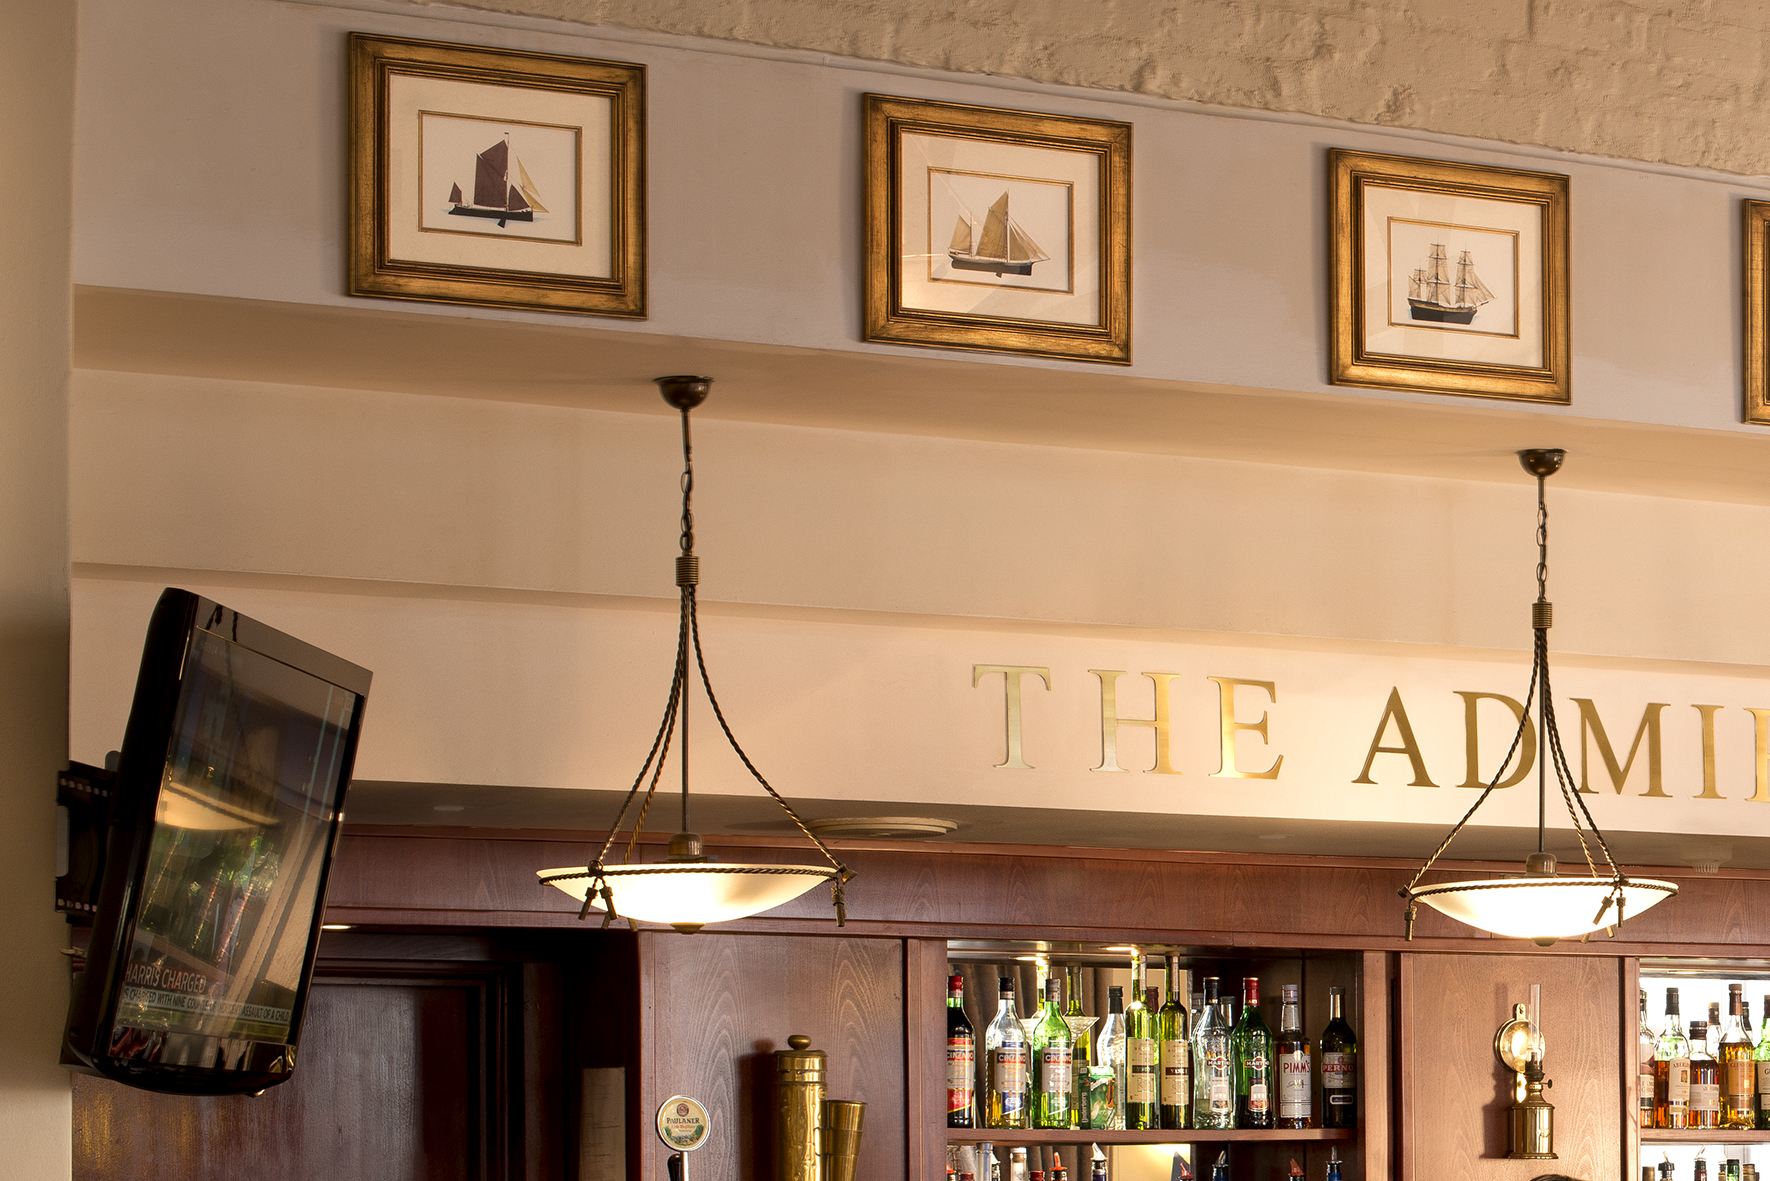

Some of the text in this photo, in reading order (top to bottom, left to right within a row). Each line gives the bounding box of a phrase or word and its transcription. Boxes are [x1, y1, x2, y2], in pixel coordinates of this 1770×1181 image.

[973, 663, 1284, 780] THE
[161, 968, 207, 994] CHARGED
[1283, 1059, 1311, 1074] PIMM'S
